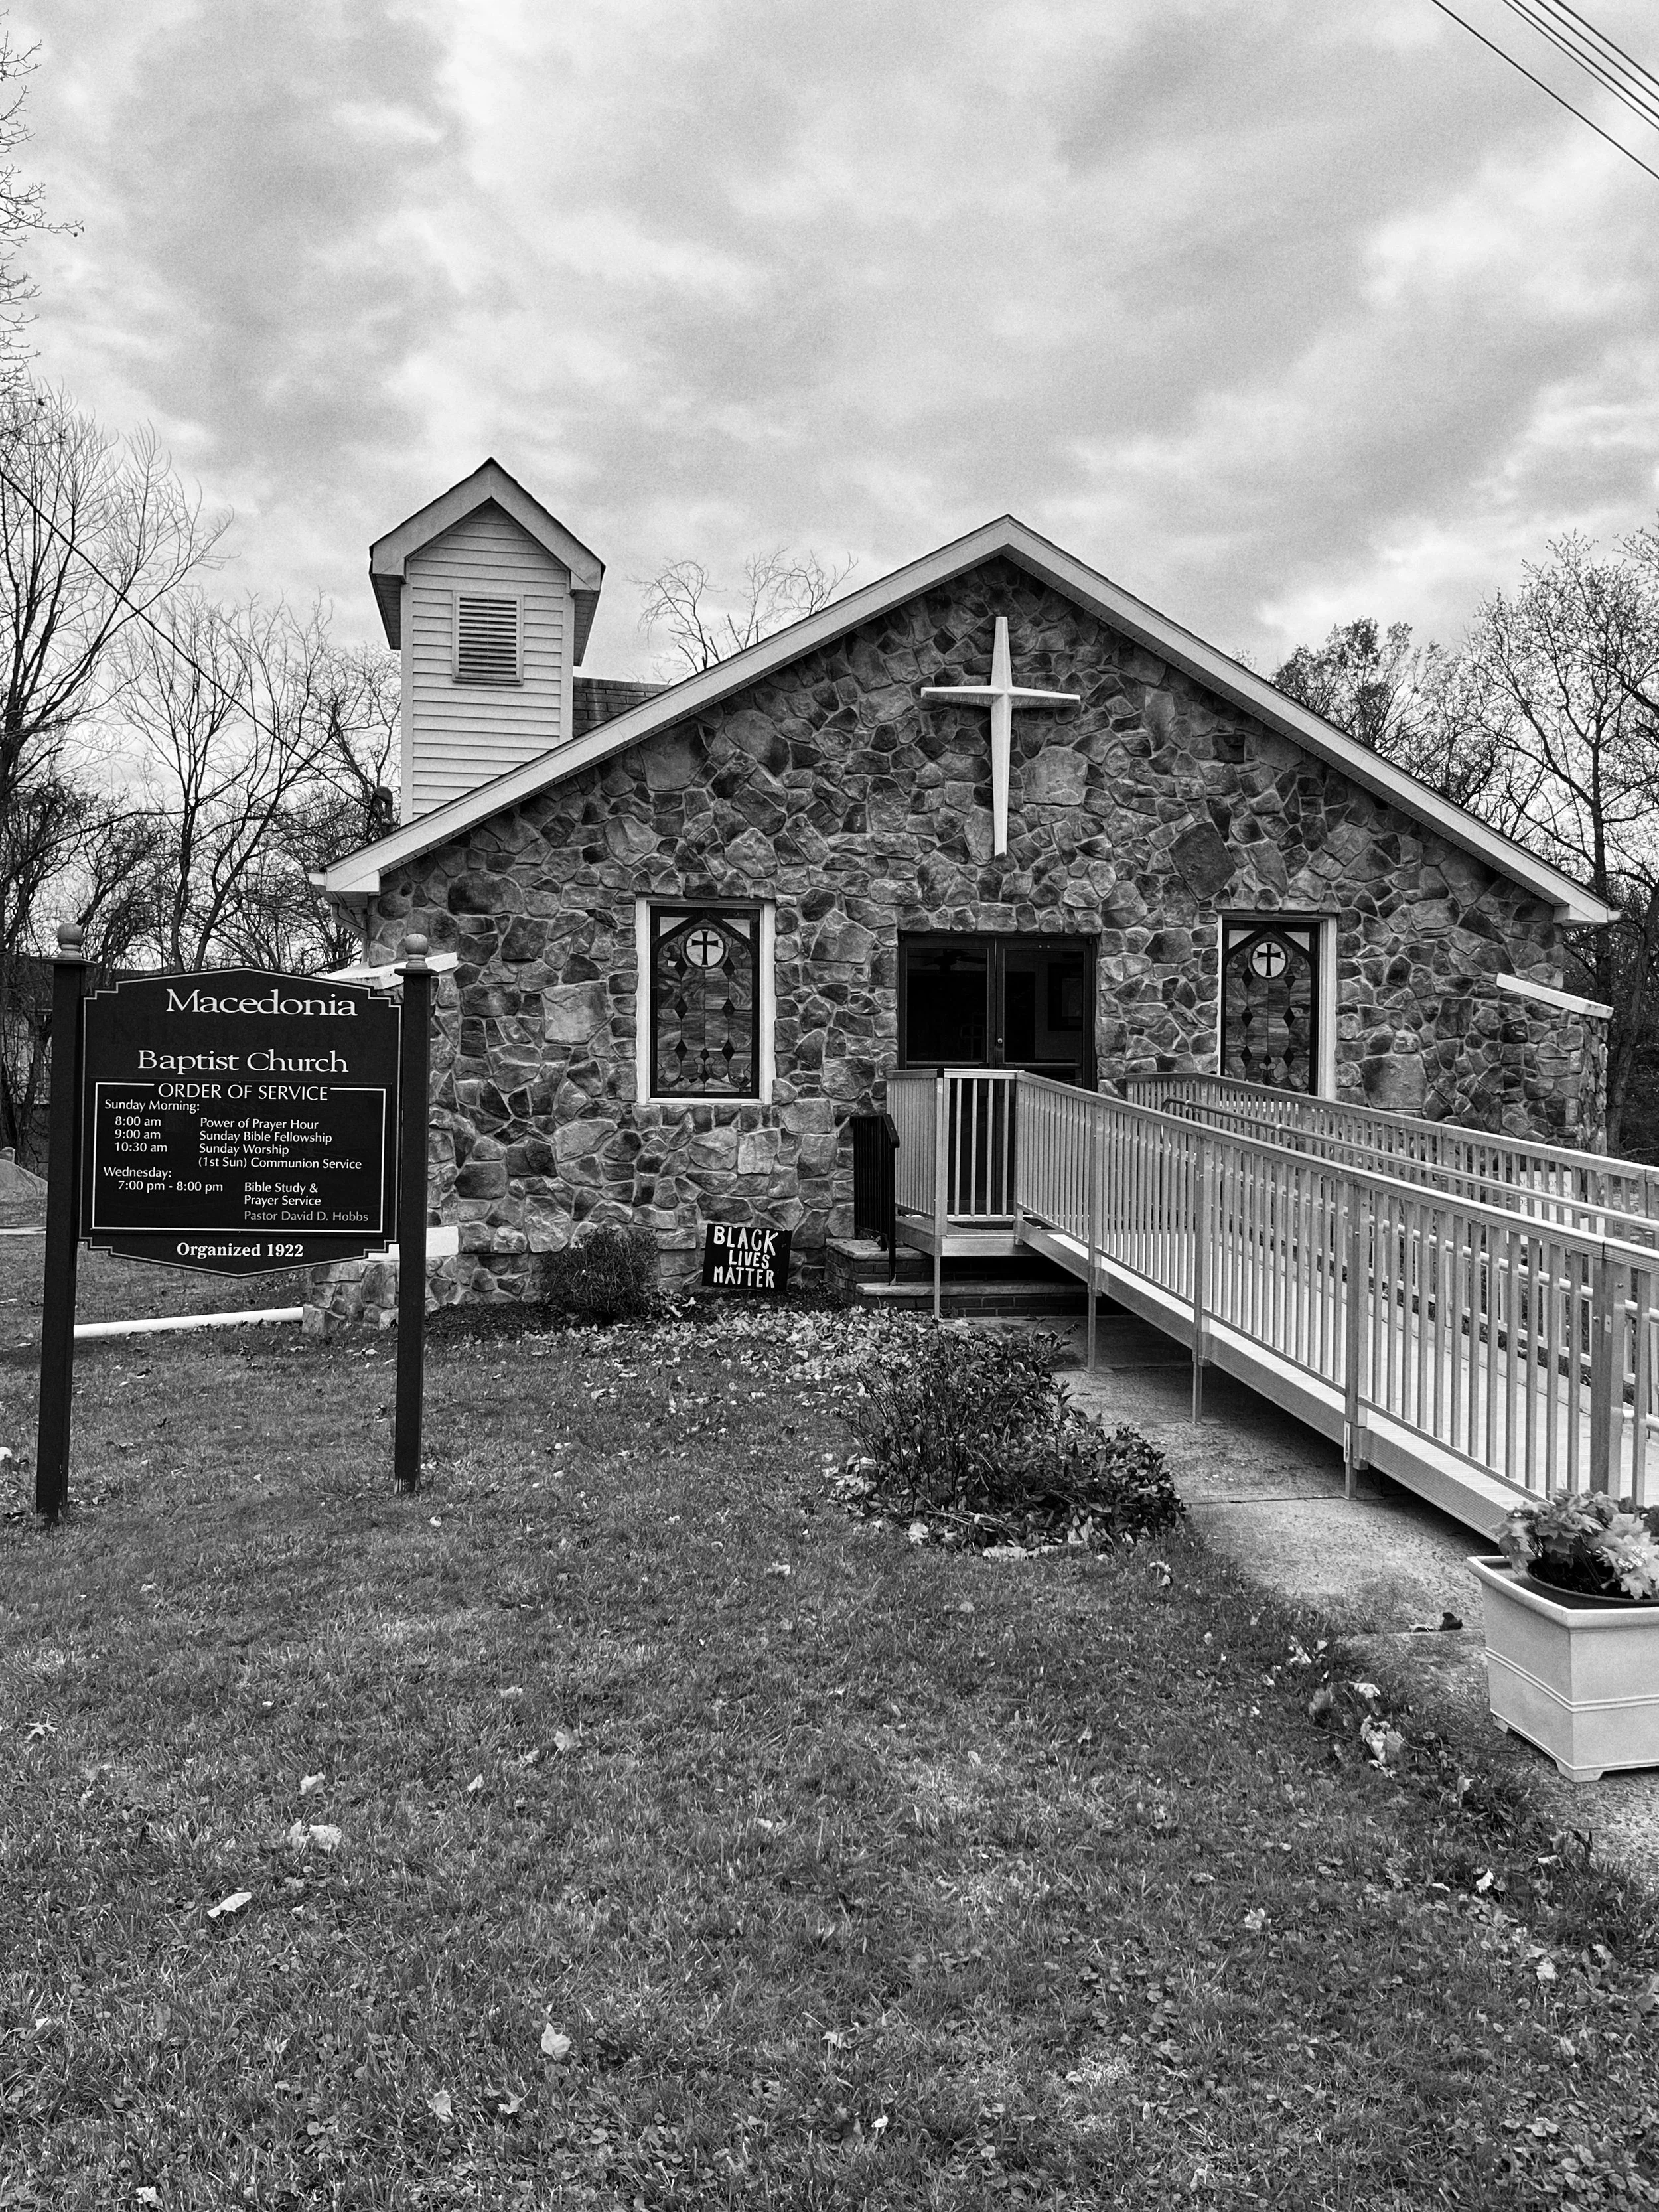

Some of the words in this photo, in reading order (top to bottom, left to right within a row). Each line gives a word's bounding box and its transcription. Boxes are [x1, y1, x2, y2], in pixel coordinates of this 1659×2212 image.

[165, 988, 359, 1017] Macedonia
[137, 1049, 240, 1075] Baptist
[246, 1048, 350, 1072] Church
[158, 1082, 222, 1099] ORDER
[227, 1084, 253, 1099] OF
[258, 1084, 328, 1101] SERVICE
[104, 1098, 146, 1113] Sunday
[149, 1100, 200, 1114] Morning:
[115, 1116, 141, 1126] 8:00
[200, 1117, 235, 1128] Power
[238, 1117, 250, 1128] of
[252, 1118, 287, 1132] Prayer
[290, 1119, 319, 1130] Hour
[114, 1128, 141, 1140] 9:00
[143, 1131, 161, 1140] am
[199, 1130, 240, 1144] Sunday
[243, 1130, 271, 1142] Bible
[274, 1131, 332, 1146] Fellowship
[114, 1142, 147, 1152] 10:30
[150, 1144, 168, 1153] am
[199, 1143, 240, 1157] Sunday
[242, 1143, 289, 1158] Worship
[198, 1157, 220, 1167] (1st
[222, 1157, 247, 1169] Sun)
[250, 1157, 319, 1169] Communion
[322, 1158, 362, 1169] Service
[103, 1166, 172, 1181] Wednesday:
[118, 1180, 144, 1191] 7:00
[147, 1183, 165, 1194] pm
[176, 1181, 202, 1191] 8:00
[204, 1183, 223, 1195] pm
[244, 1181, 272, 1193] Bible
[275, 1181, 307, 1196] Study
[309, 1183, 319, 1193] &
[244, 1195, 279, 1209] Prayer
[281, 1195, 321, 1206] Service
[244, 1210, 278, 1221] Pastor
[281, 1210, 313, 1221] David
[317, 1211, 328, 1221] D.
[332, 1211, 369, 1222] Hobbs
[713, 1225, 779, 1256] BLACK
[176, 1242, 261, 1260] Organized
[267, 1243, 303, 1258] 1922
[728, 1249, 770, 1270] LIVES
[713, 1266, 776, 1289] MATTER
